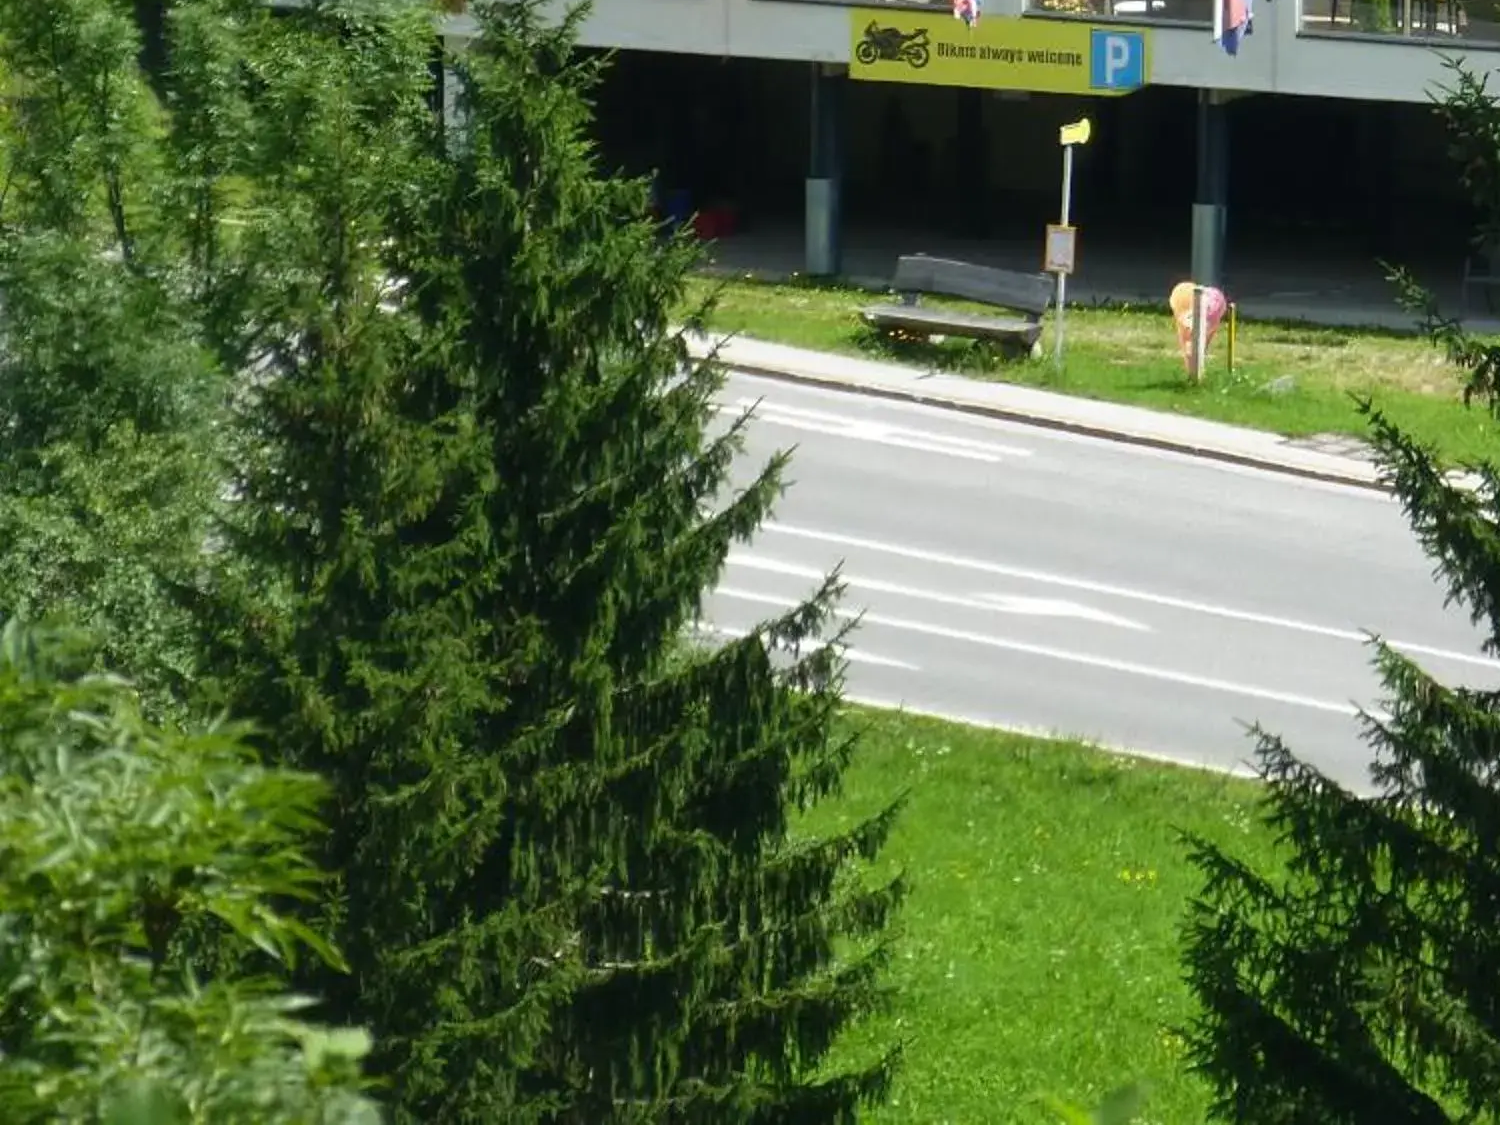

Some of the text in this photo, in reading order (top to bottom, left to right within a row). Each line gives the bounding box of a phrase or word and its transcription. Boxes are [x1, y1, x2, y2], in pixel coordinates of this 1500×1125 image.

[937, 42, 1083, 66] Bikers always welcome
[1105, 35, 1129, 83] P
